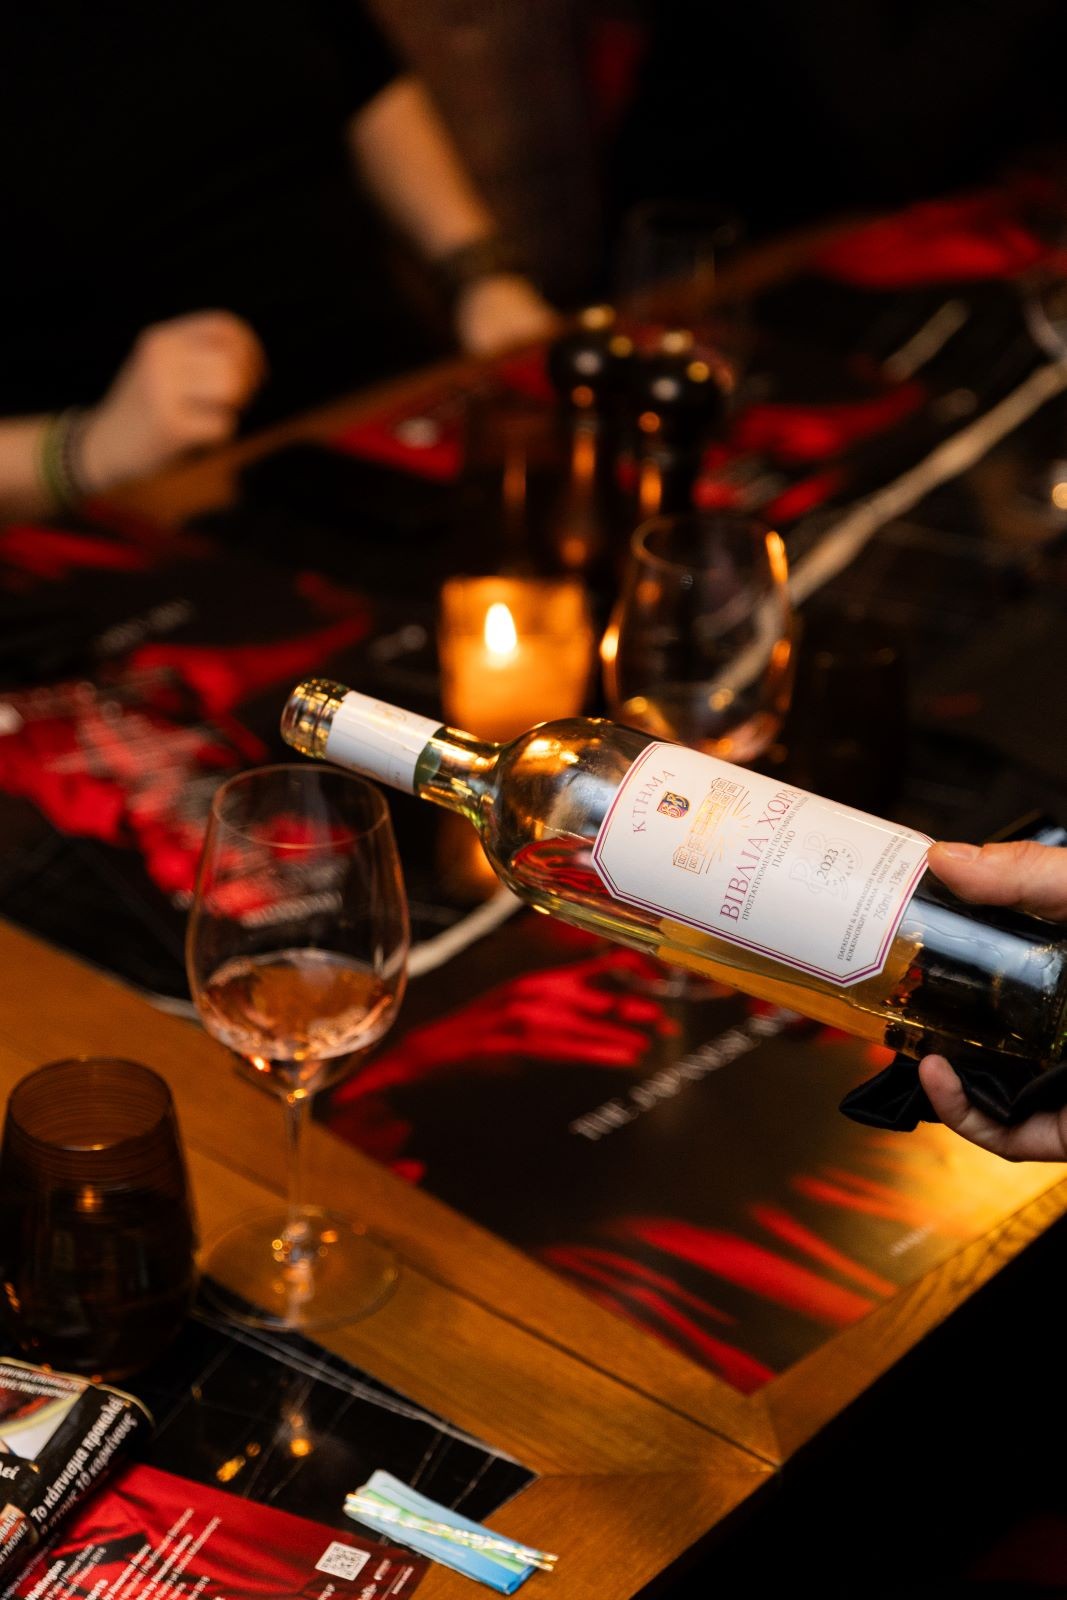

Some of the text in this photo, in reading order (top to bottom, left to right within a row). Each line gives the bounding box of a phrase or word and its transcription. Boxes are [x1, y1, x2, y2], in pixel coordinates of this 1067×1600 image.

[632, 769, 675, 831] ΚΤΗΜΑ
[719, 788, 801, 920] ΒΙΒΛΙΑ ΧΩΡΑ
[771, 829, 795, 867] ΠΑΓΓΑΙΟ
[815, 847, 839, 879] 2023
[742, 847, 774, 919] ΠΡΟΣΤΑΤΕΥΟΜΕΝΗ
[872, 891, 893, 920] 750ml
[836, 923, 854, 959] ΠΑΡΑΓΩΓΗ
[29, 1501, 50, 1523] Το
[43, 1447, 90, 1508] κάπνισμα
[83, 1393, 126, 1451] προκαλεί
[73, 1470, 94, 1490] 10
[86, 1412, 140, 1477] καρκίνους
